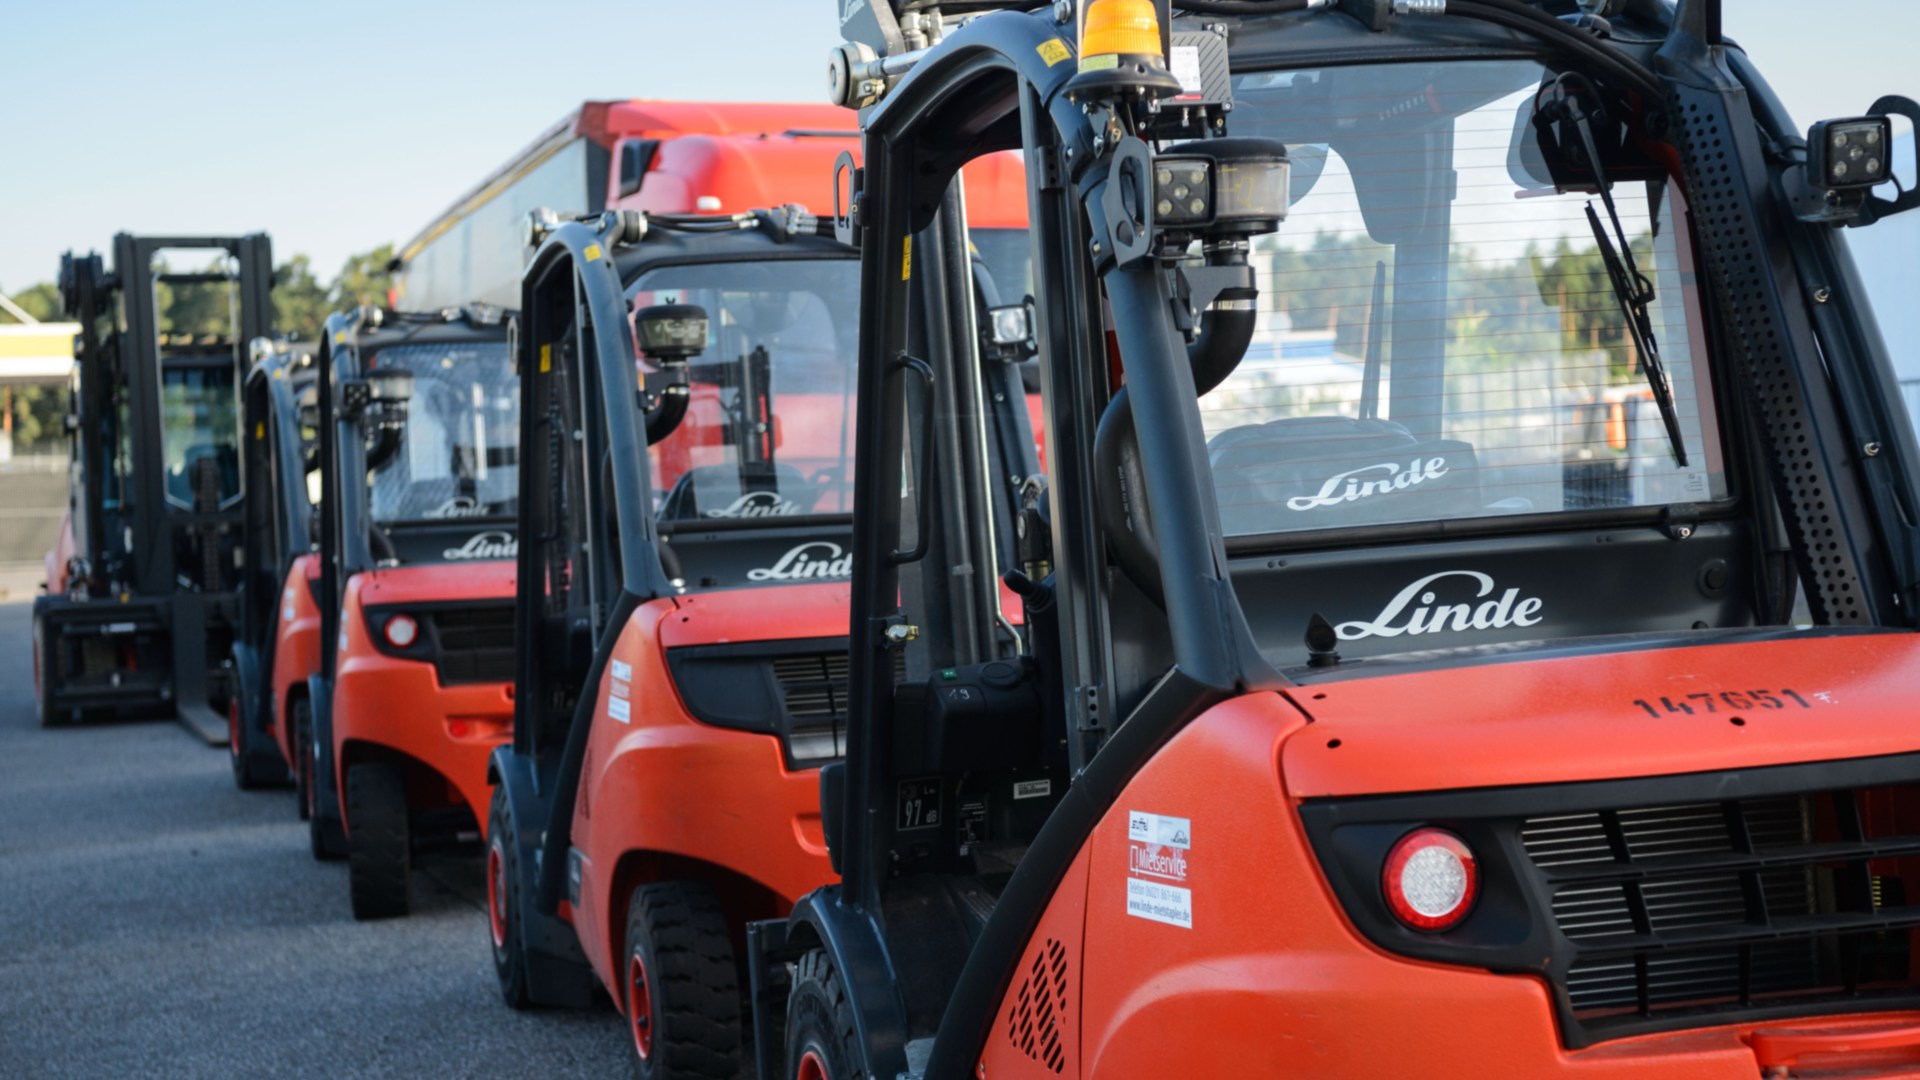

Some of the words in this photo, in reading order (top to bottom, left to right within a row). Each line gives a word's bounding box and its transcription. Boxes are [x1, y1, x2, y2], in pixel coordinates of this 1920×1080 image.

[1286, 456, 1450, 511] Linde
[442, 531, 518, 560] Lind
[746, 541, 853, 580] Lind
[1333, 570, 1543, 640] Linde
[1633, 688, 1811, 718] 147651
[905, 798, 922, 827] 97
[926, 810, 937, 823] dB
[1139, 848, 1187, 877] Mietservice
